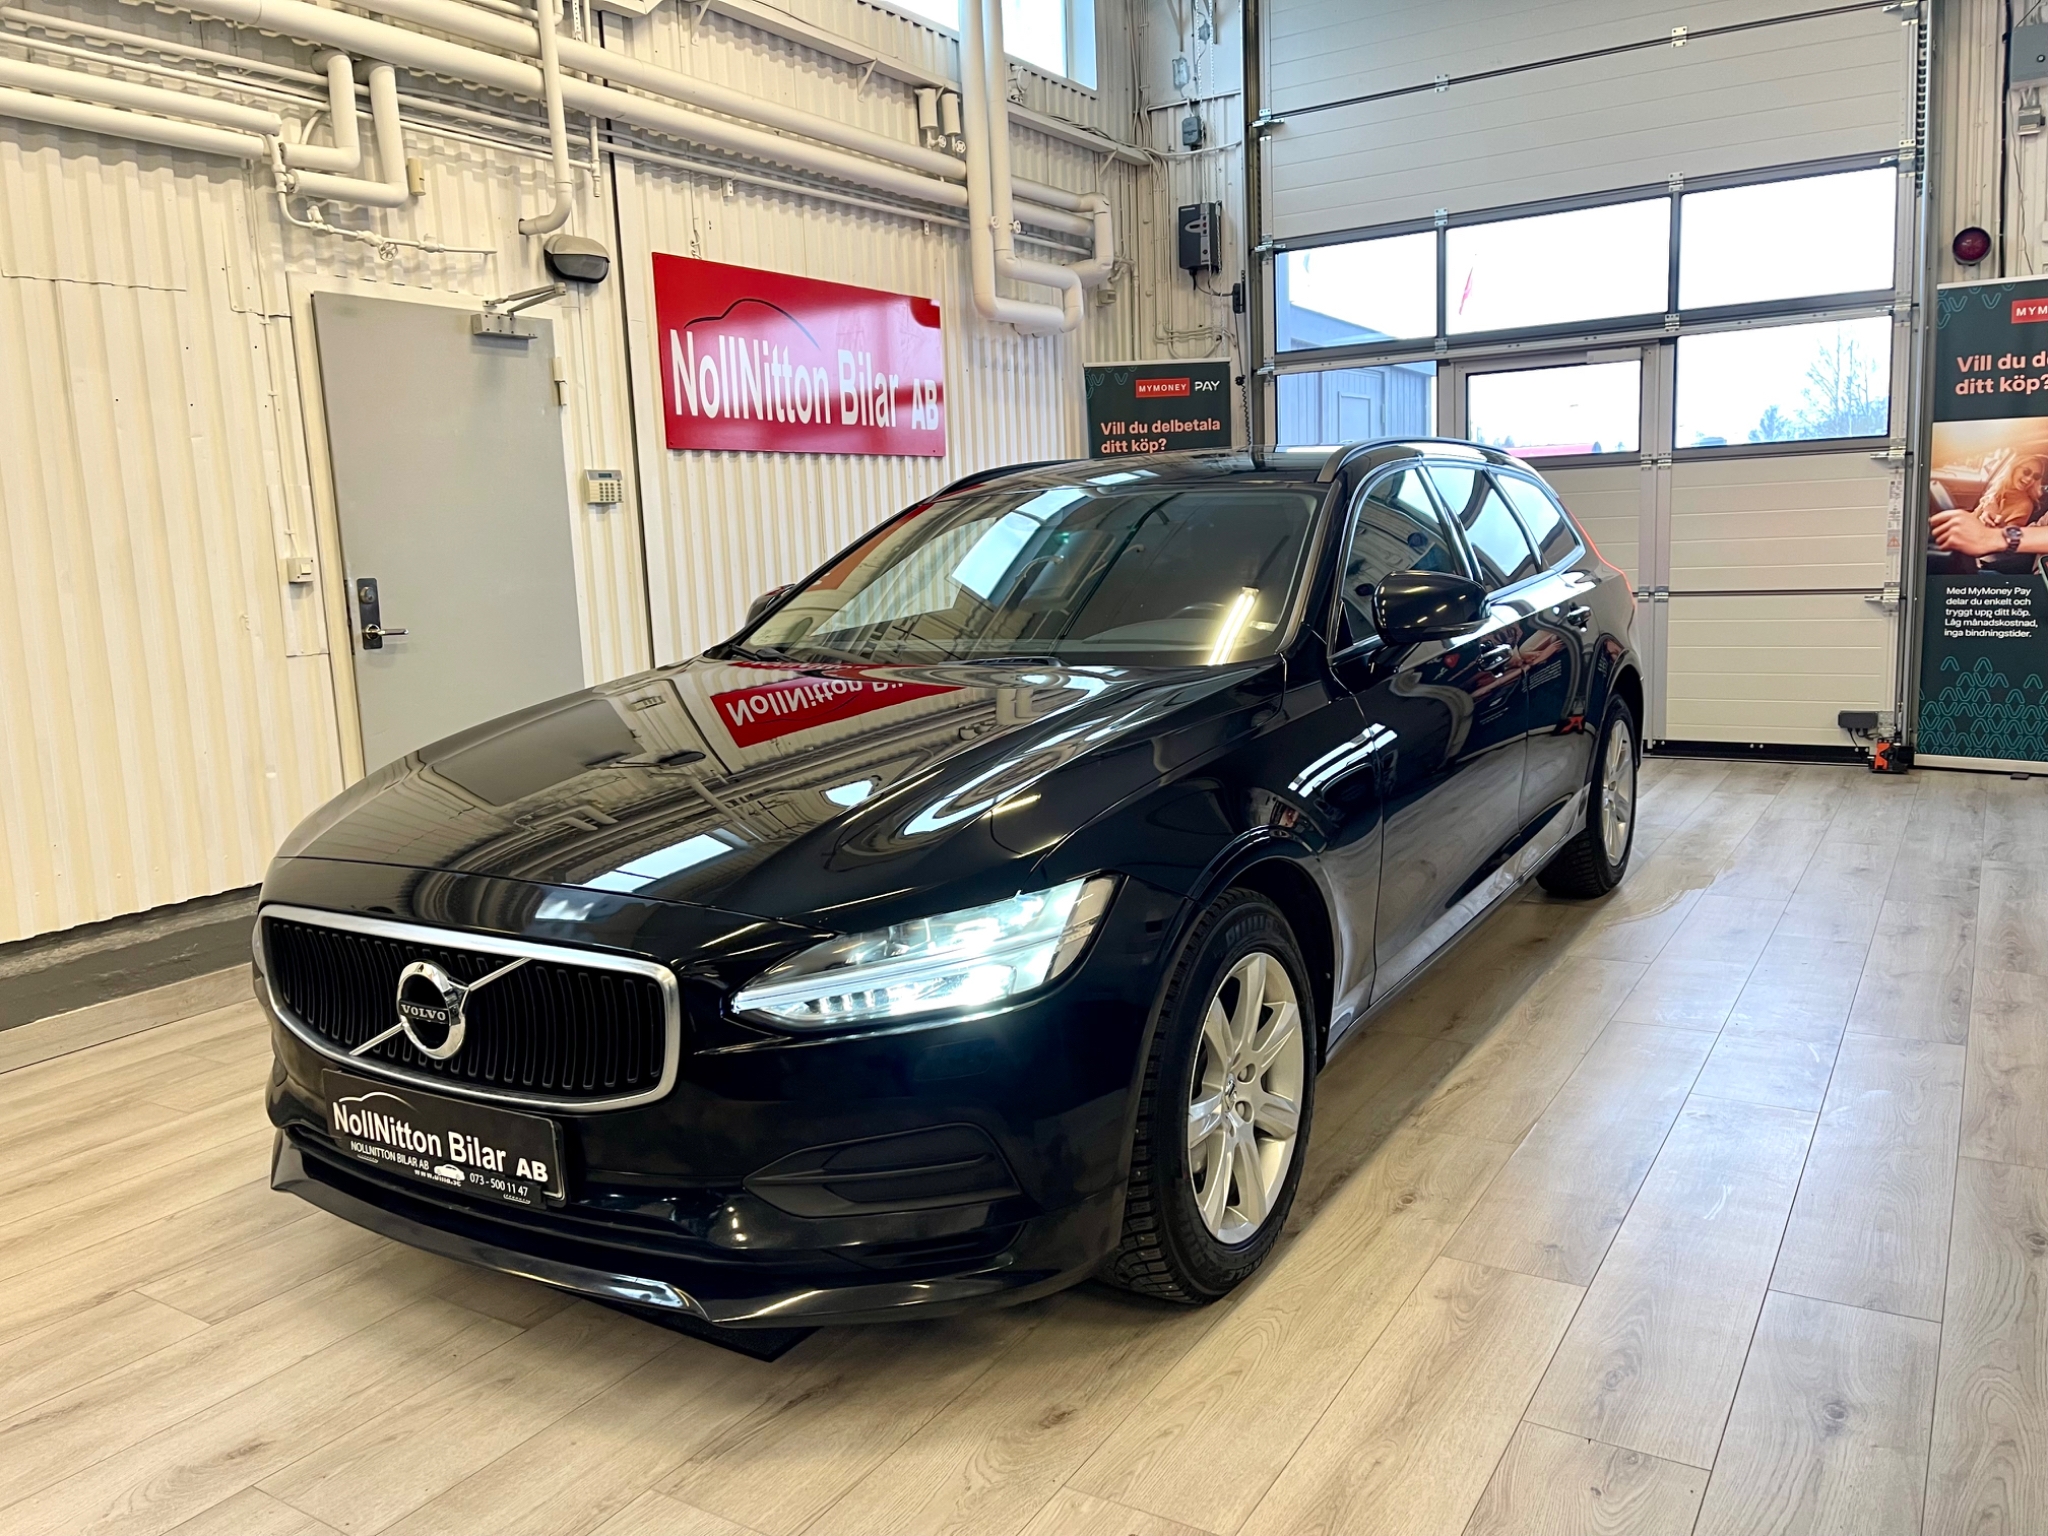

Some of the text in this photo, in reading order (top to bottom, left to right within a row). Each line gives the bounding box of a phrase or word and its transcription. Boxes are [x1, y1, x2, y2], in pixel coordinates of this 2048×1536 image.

[1956, 350, 2048, 373] Vill du d
[670, 328, 939, 430] NollNitton Bilar AB
[1138, 380, 1221, 393] MYMONEY PAY
[1955, 373, 2048, 395] ditt köp?
[1100, 418, 1221, 436] Vill du delbetala
[1101, 438, 1167, 454] ditt köp?
[1946, 587, 2031, 597] Med MyMoney Pay
[1946, 597, 2031, 606] delar du enkelt och
[1945, 608, 2031, 618] tryggt upp ditt köp.
[1944, 618, 2039, 628] Låg månadskostnad,
[1944, 628, 2032, 639] inga bindningstider.
[401, 1004, 446, 1021] VOLVO
[332, 1101, 549, 1183] NollNitton Bilar AB
[350, 1140, 430, 1170] NOLLNITTON BILAR AB
[469, 1172, 485, 1186] 073
[490, 1178, 506, 1191] 500
[507, 1182, 516, 1193] 11
[518, 1185, 529, 1197] 47
